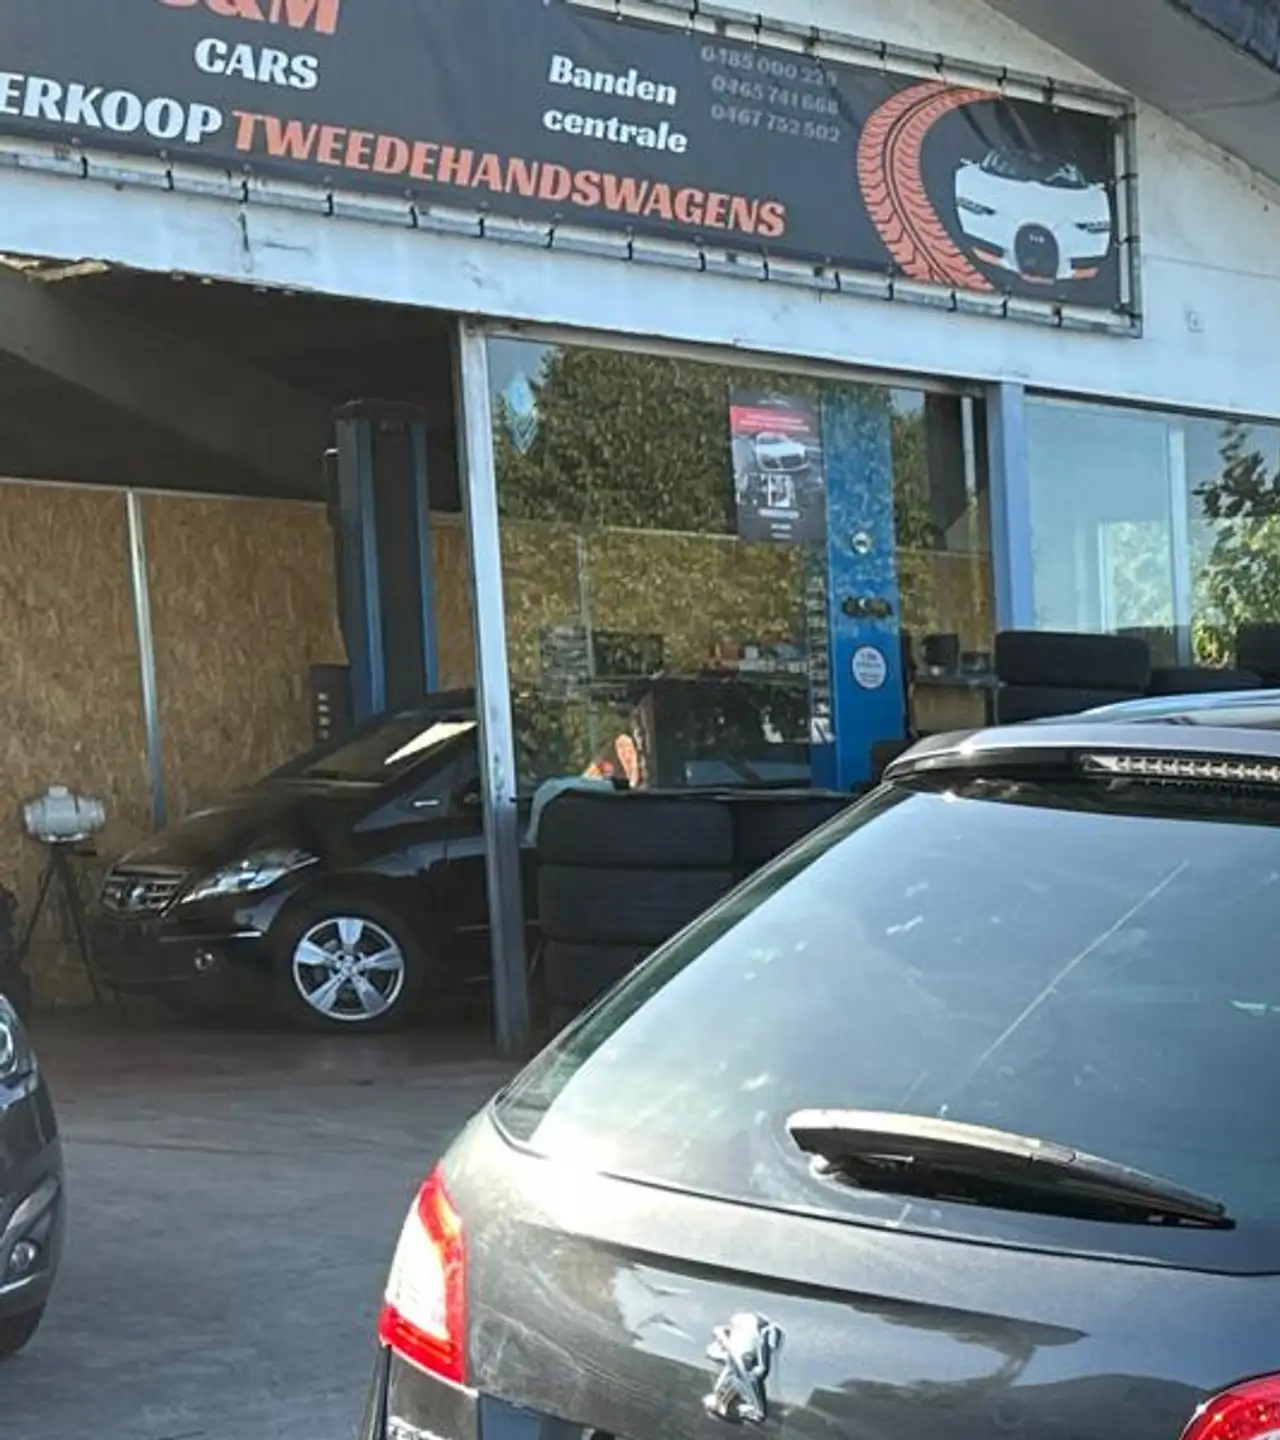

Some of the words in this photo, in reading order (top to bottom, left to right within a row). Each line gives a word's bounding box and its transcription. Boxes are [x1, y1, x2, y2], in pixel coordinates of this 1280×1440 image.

[194, 38, 319, 90] CARS
[549, 54, 677, 105] Banden
[542, 109, 688, 153] centrale
[231, 110, 787, 238] TWEEDEHANDSWAGENS
